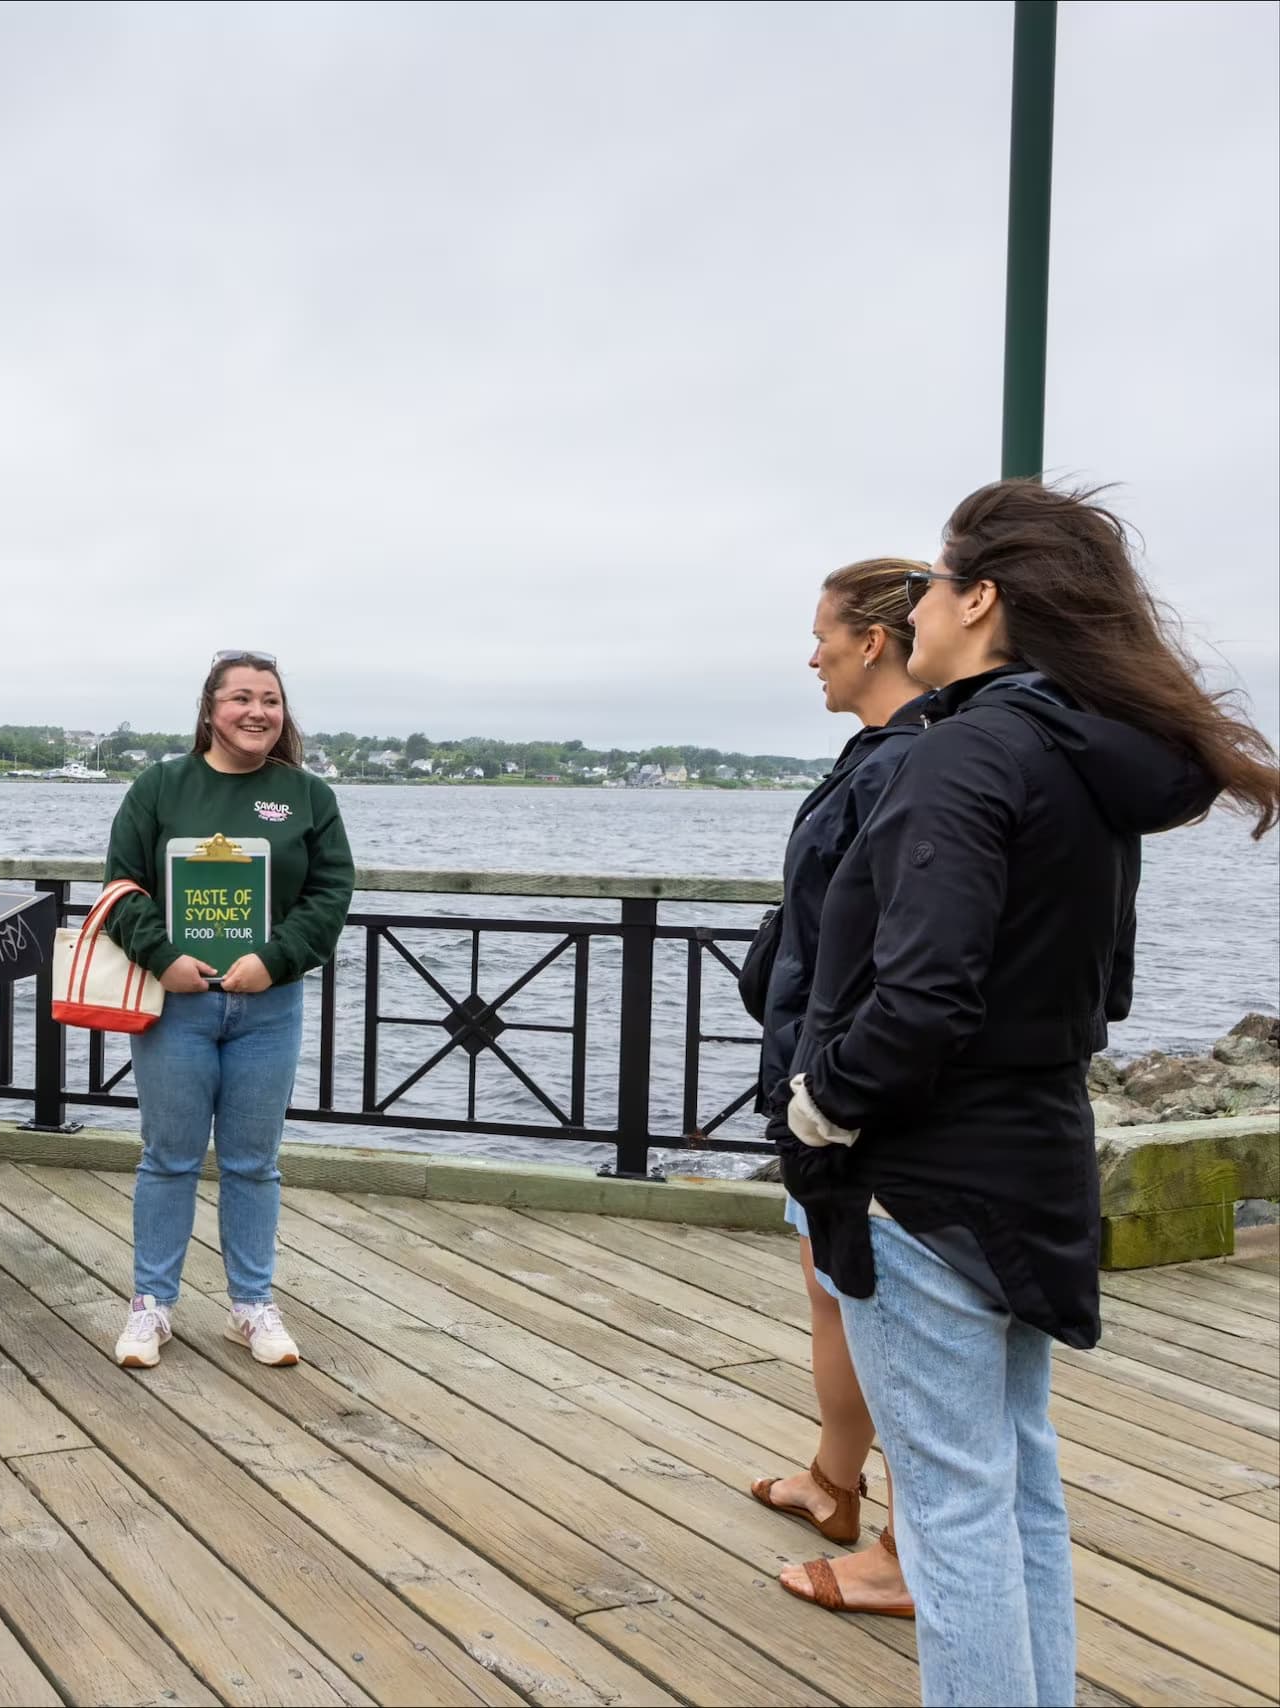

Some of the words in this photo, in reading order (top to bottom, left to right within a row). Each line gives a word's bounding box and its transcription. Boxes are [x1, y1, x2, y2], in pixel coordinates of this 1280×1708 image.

[254, 801, 293, 815] SAVOUR
[184, 889, 228, 905] TASTE
[234, 889, 252, 905] OF
[185, 908, 252, 921] SYDNEY
[185, 928, 215, 939] FOOD
[224, 928, 253, 939] TOUR
